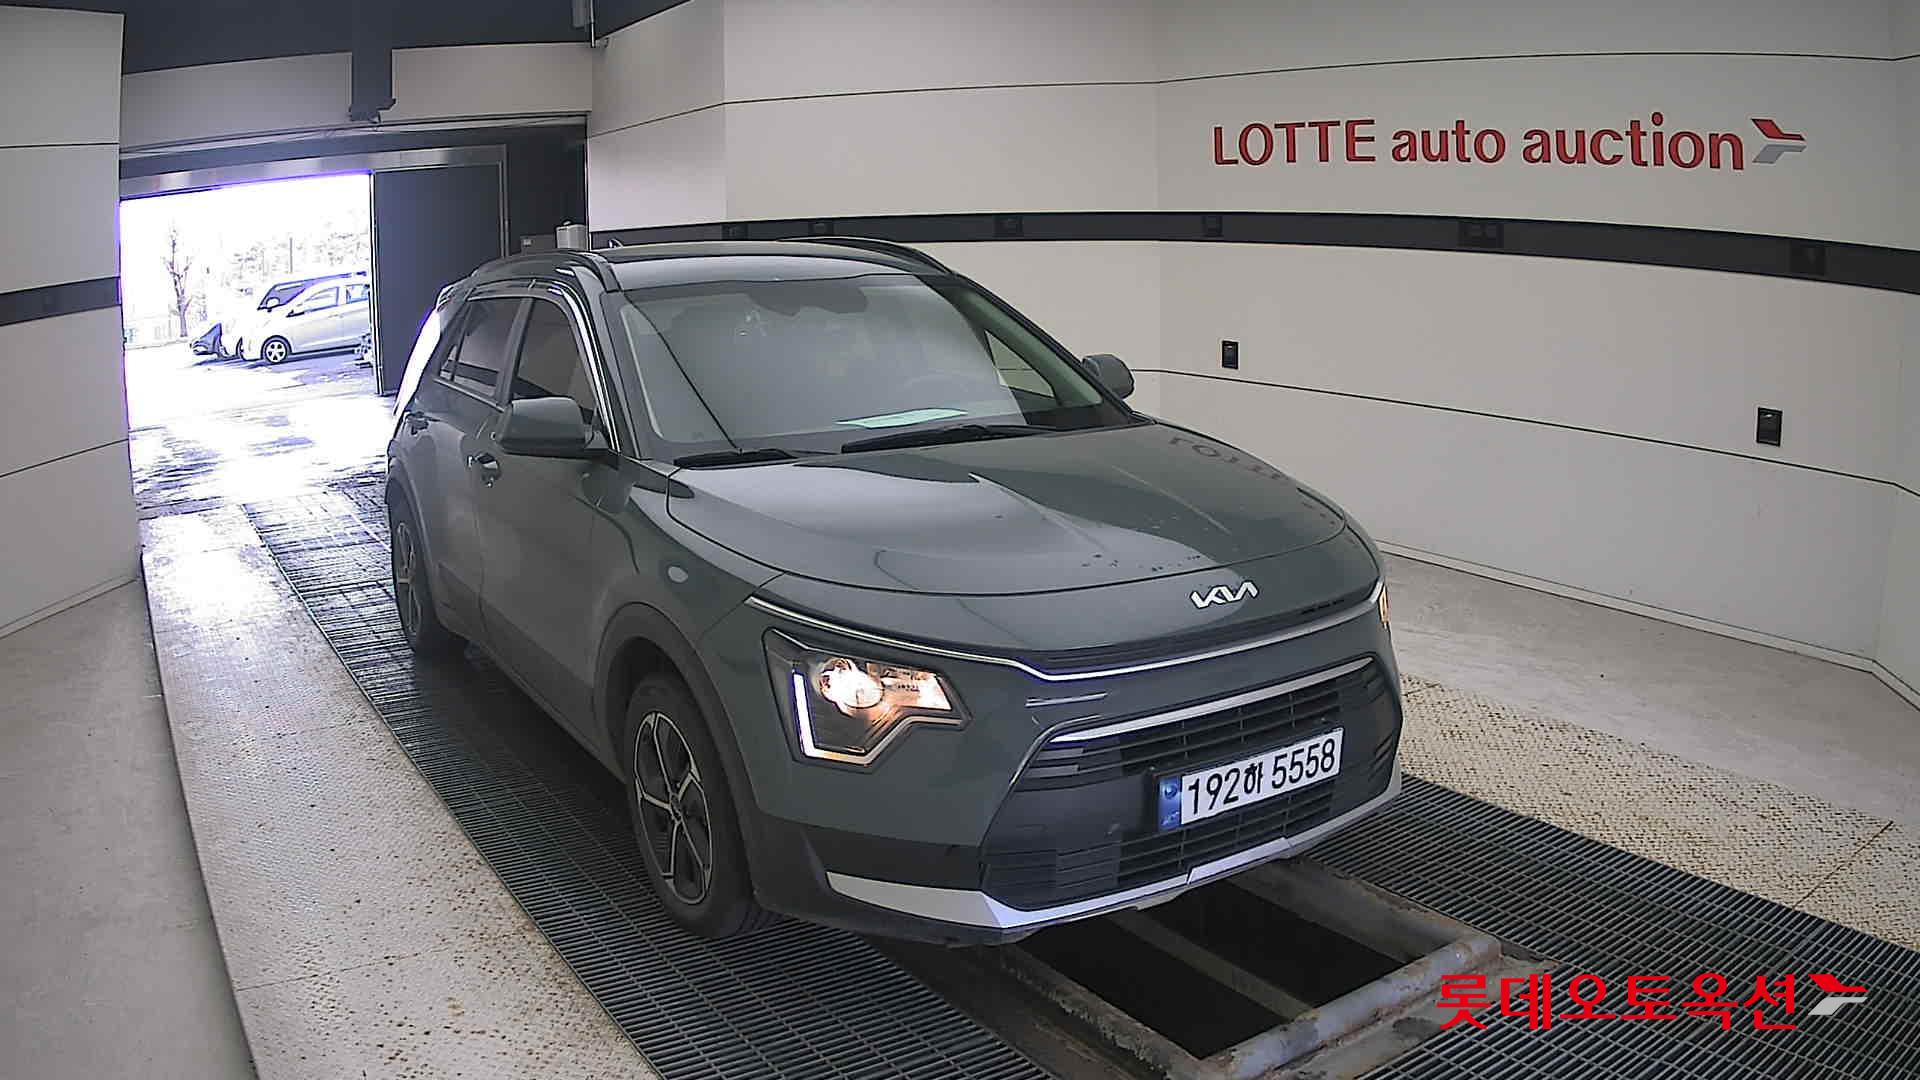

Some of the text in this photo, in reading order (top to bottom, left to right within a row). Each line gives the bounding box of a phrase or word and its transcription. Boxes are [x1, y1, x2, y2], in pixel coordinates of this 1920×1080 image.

[1213, 111, 1745, 171] LOTTE auto auction
[1190, 580, 1259, 610] KIA
[1187, 737, 1337, 816] 192하 5558
